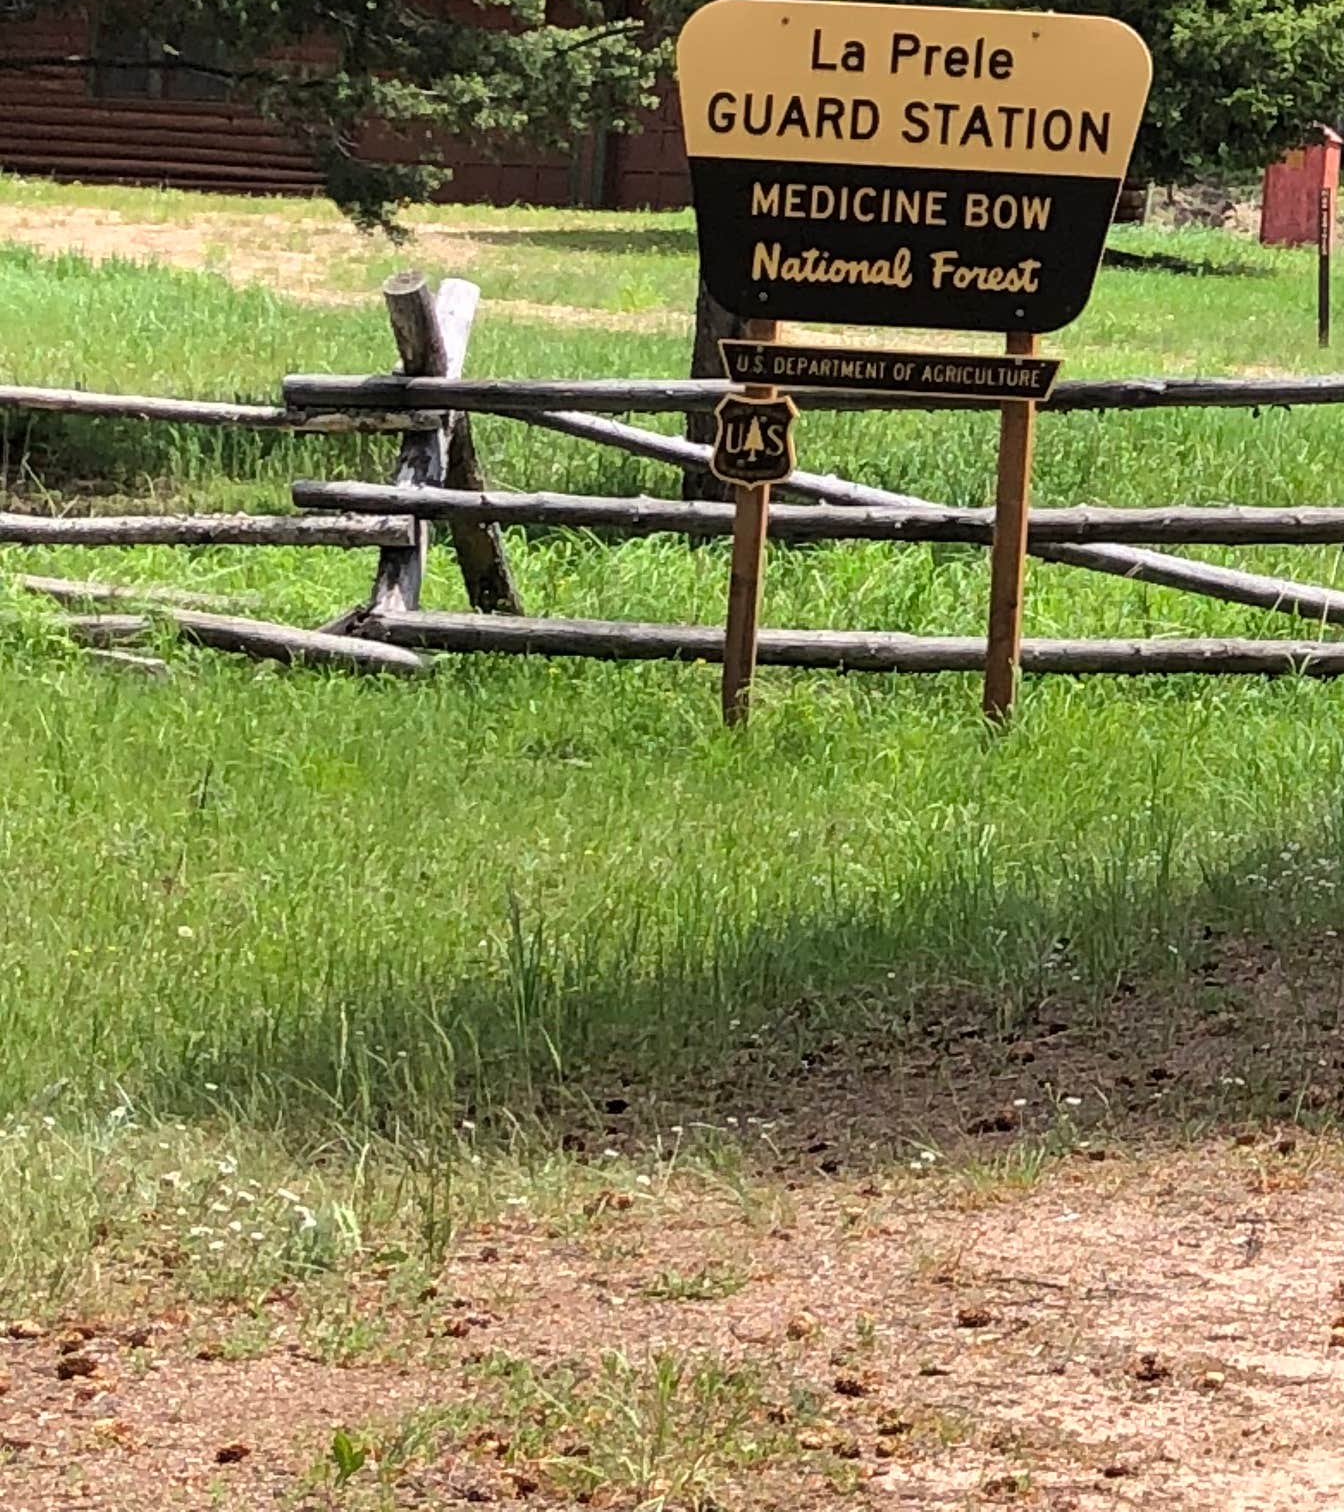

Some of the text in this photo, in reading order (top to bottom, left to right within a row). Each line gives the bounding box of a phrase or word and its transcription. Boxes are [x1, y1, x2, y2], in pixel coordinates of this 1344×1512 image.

[811, 29, 1014, 80] La Prele
[707, 92, 1110, 154] GUARD STATION
[751, 182, 1051, 231] MEDICINE BOW
[751, 242, 1042, 293] National Forest
[773, 356, 887, 380] DEPARTMENT
[893, 362, 917, 381] OF
[921, 364, 1041, 388] AGRICULTURE
